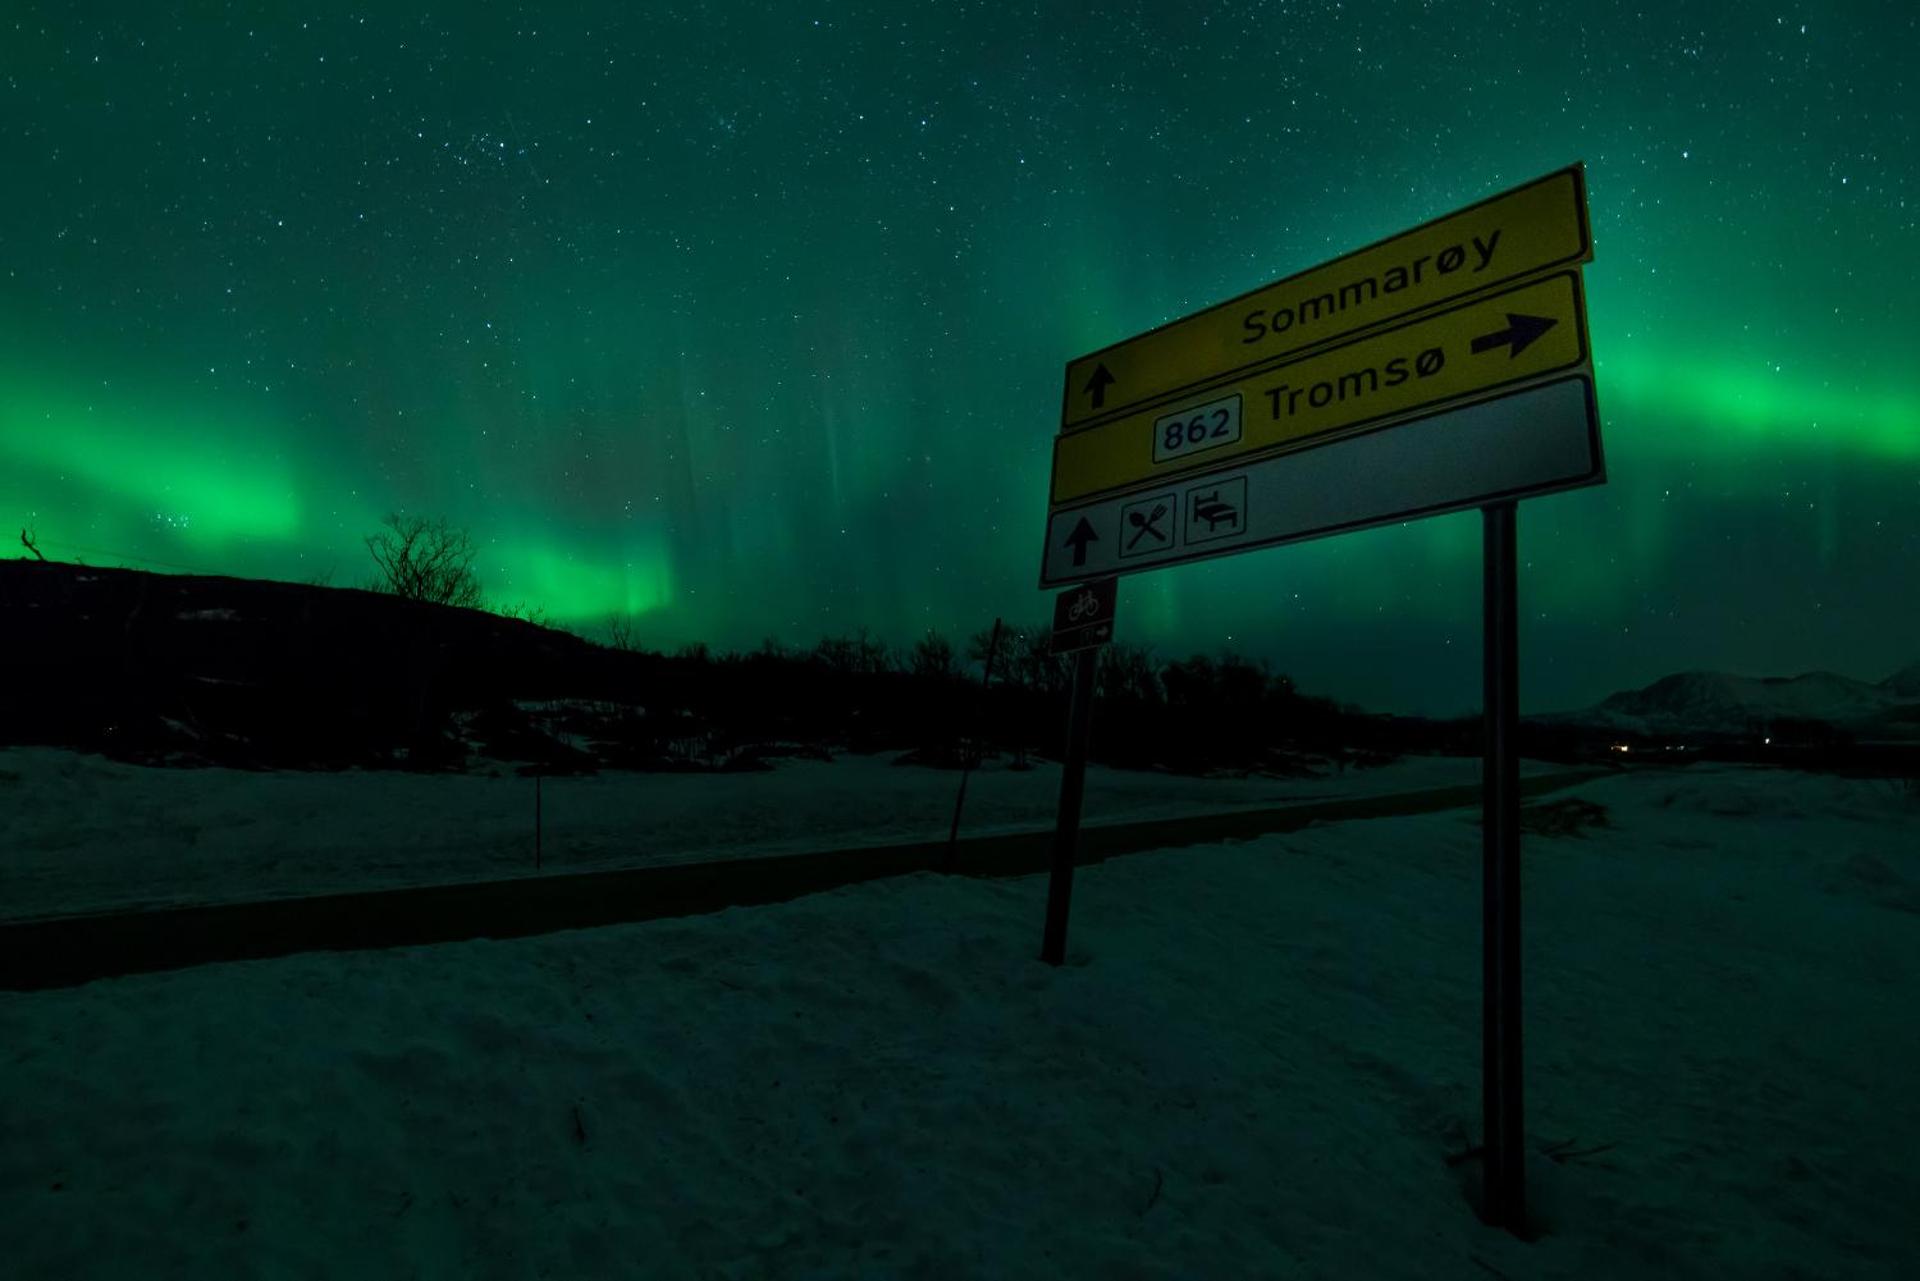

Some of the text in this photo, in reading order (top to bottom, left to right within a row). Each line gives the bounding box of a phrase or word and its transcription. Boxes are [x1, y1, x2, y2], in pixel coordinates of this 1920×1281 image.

[1243, 230, 1501, 343] Sommarøy
[1164, 347, 1446, 450] 862 Tromsø
